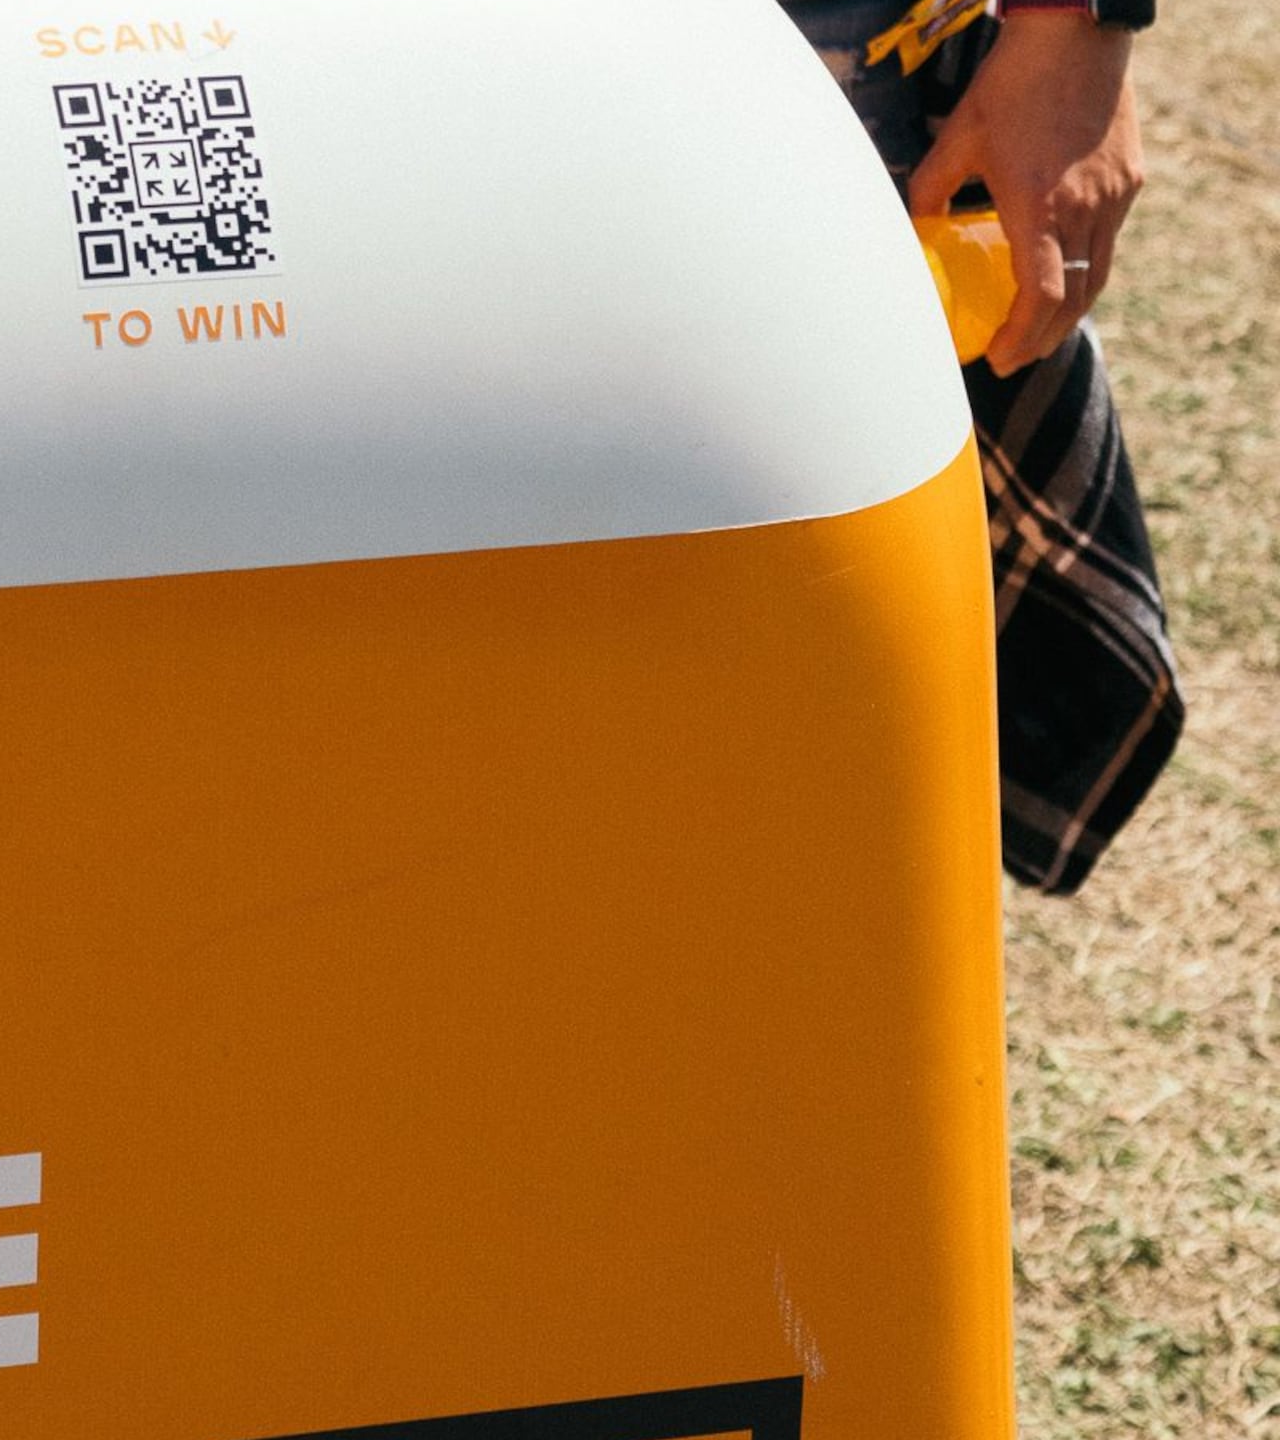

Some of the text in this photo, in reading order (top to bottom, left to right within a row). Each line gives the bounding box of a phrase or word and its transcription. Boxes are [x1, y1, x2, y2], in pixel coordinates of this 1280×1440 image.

[36, 21, 187, 58] SCAN
[83, 301, 287, 348] TO WIN
